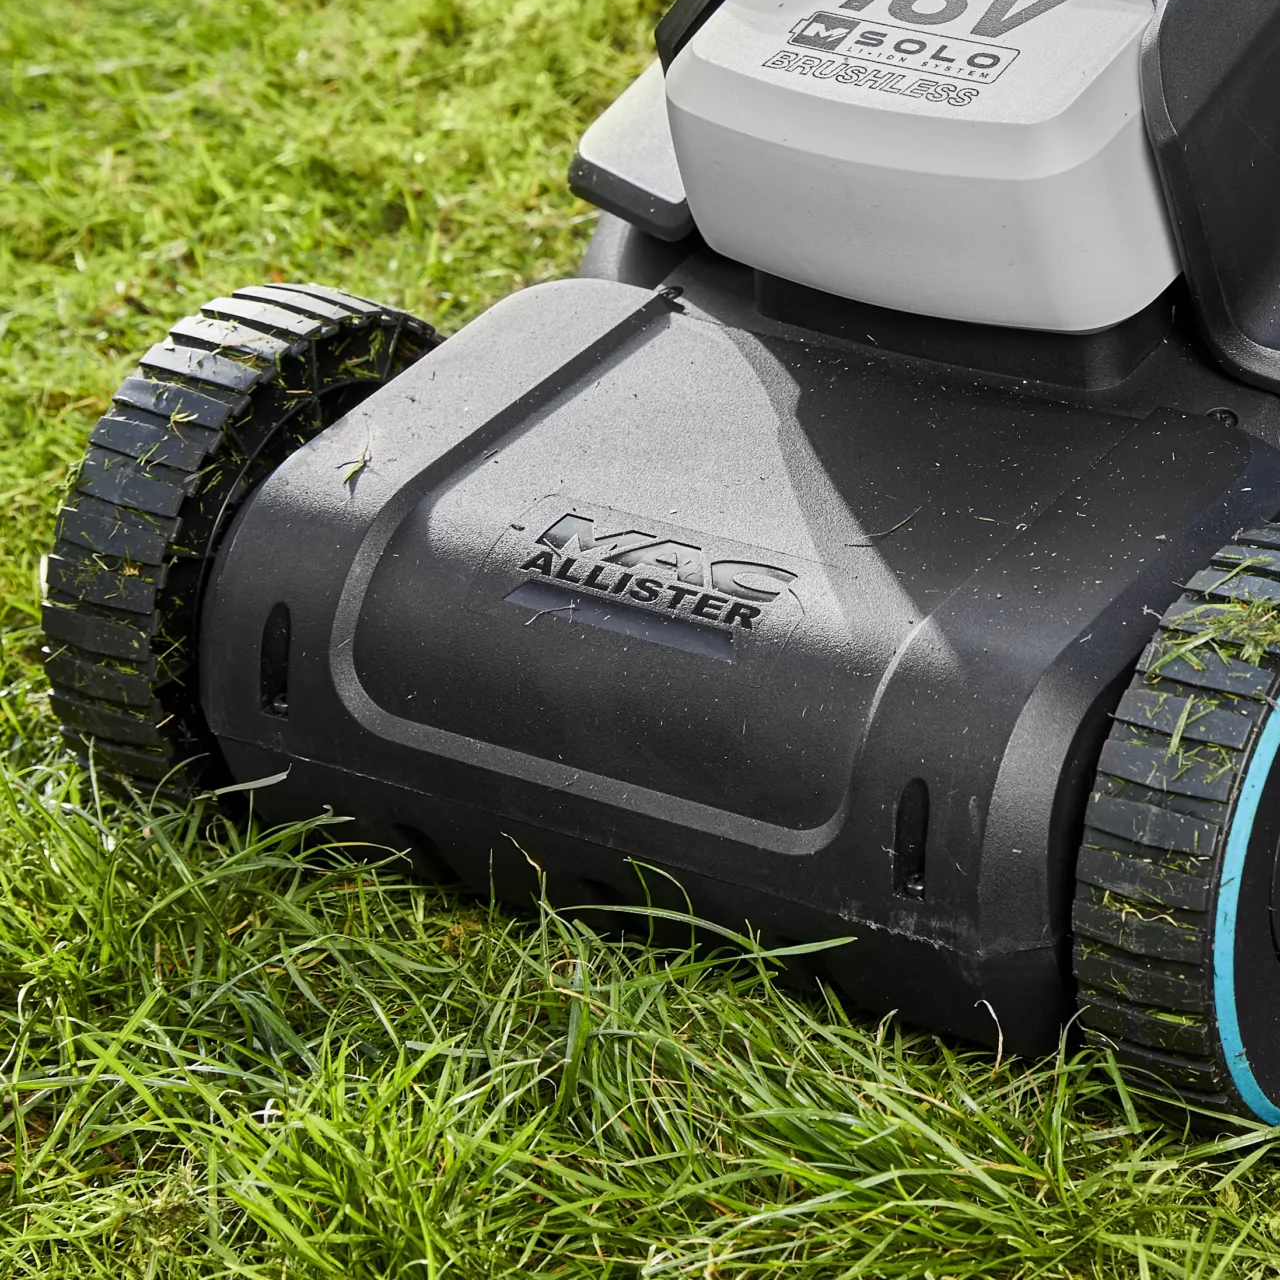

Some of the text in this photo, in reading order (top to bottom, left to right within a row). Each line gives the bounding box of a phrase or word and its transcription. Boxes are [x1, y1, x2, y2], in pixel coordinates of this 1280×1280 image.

[761, 49, 980, 107] BRUSHLESS
[846, 45, 990, 79] LI-ION SYSTEM
[854, 30, 1001, 69] SOLO
[535, 512, 799, 603] MAC
[519, 550, 762, 630] ALLISTER
